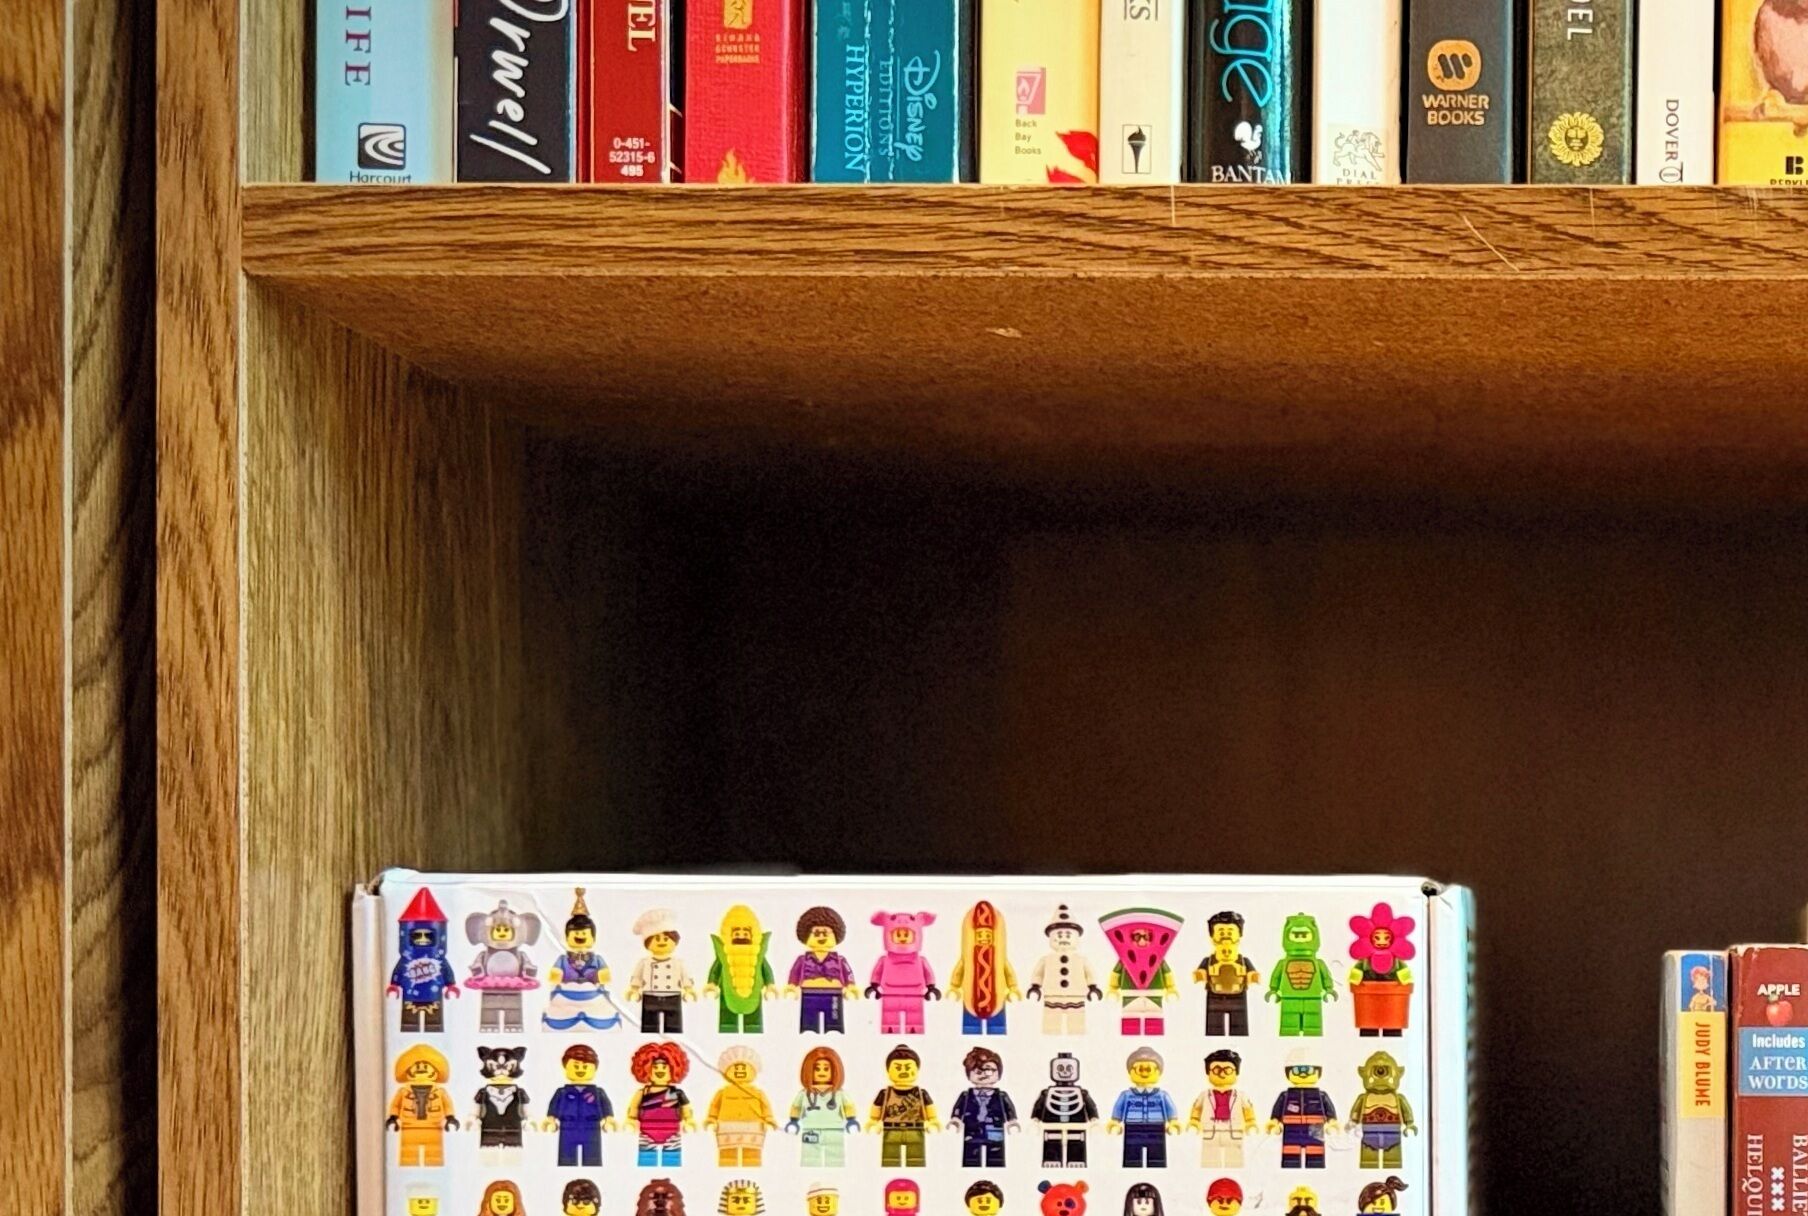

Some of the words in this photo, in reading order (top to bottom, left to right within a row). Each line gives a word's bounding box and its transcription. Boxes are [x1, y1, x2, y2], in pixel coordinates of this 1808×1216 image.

[1423, 94, 1489, 109] WARNER
[844, 44, 866, 173] HYPERION
[1015, 119, 1037, 128] Back
[1427, 110, 1484, 125] BOOKS
[1665, 99, 1679, 161] DOVER
[612, 138, 650, 149] 0-451-
[1015, 132, 1031, 142] Bay
[609, 151, 656, 163] 52315-6
[1015, 146, 1041, 155] Books
[620, 164, 644, 176] 495
[1342, 167, 1377, 180] DIAL
[1757, 983, 1801, 996] APPLE
[1695, 1022, 1711, 1056] JUDY
[1752, 1034, 1806, 1049] Includes
[1695, 1061, 1711, 1106] BLUME
